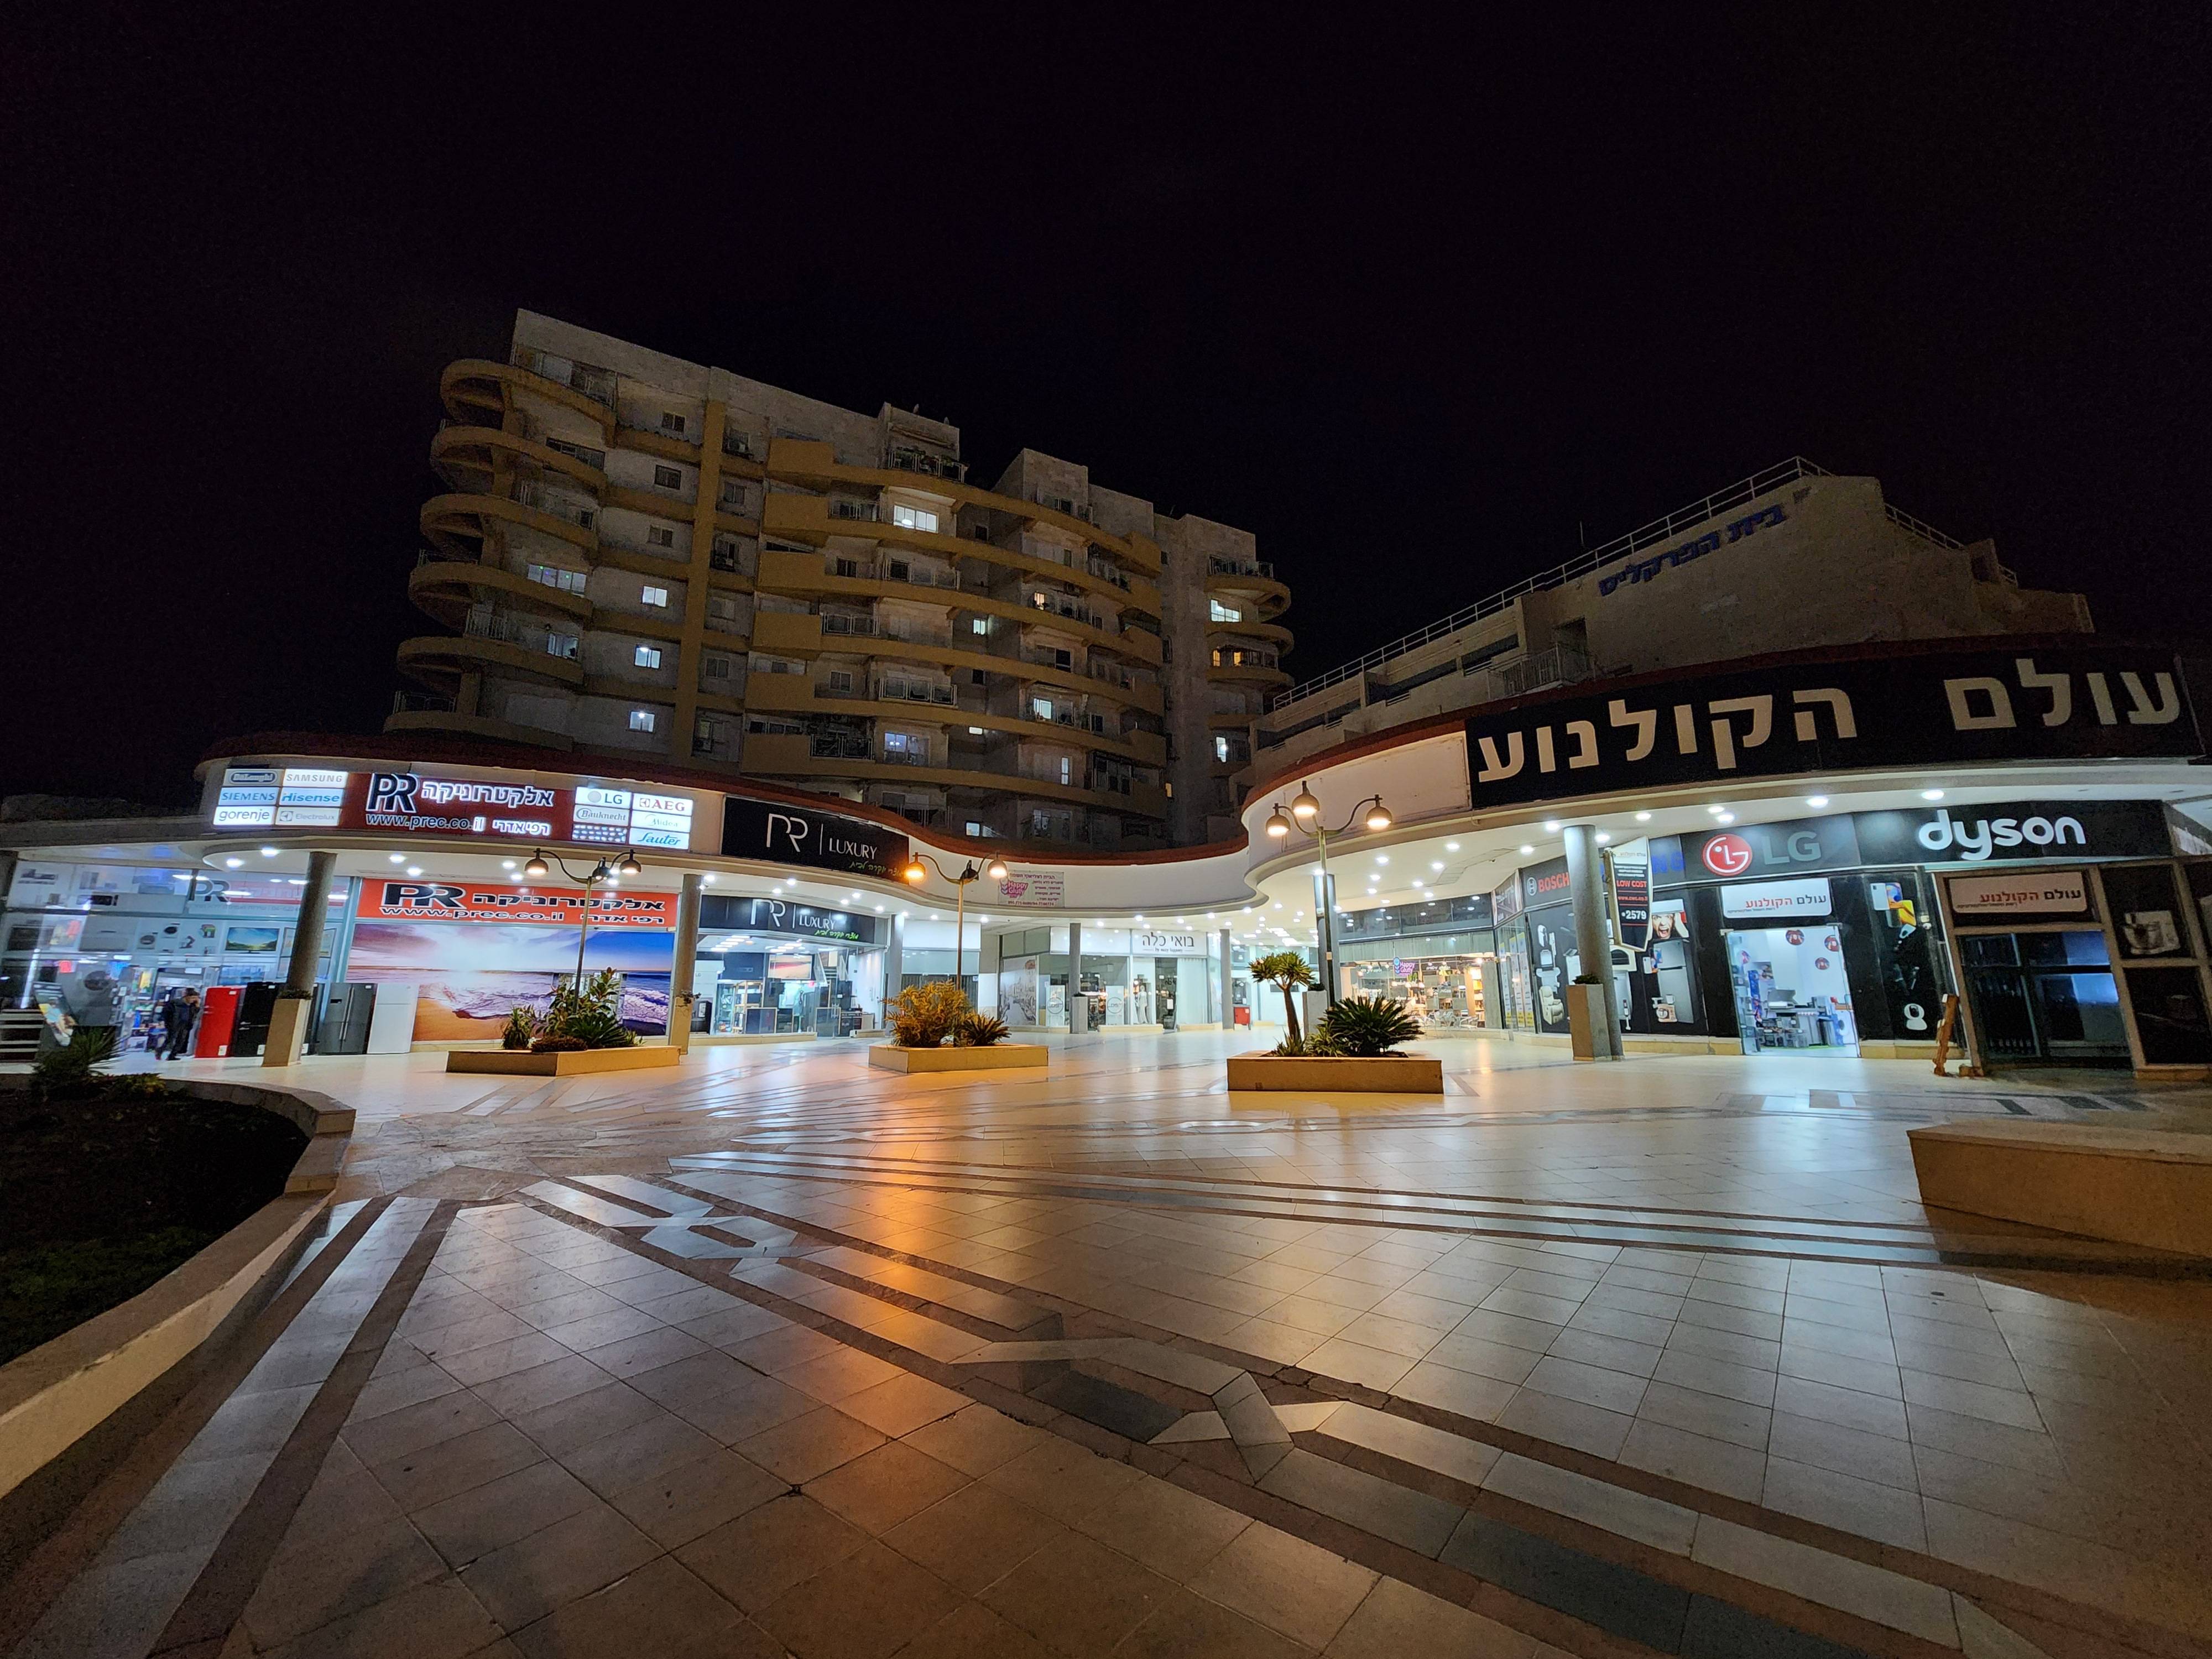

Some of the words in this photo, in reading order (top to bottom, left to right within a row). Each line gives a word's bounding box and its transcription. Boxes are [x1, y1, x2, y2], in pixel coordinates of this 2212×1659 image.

[1726, 504, 1787, 544] בית
[1943, 658, 2181, 731] עולם
[1478, 687, 1858, 783] הקולנוע
[286, 774, 342, 782] SAMSUNG
[222, 792, 275, 801] SIEMENS
[281, 792, 340, 802] Hisense
[366, 773, 418, 813] PR
[421, 781, 555, 808] אלקטרוניקה
[604, 793, 623, 805] LG
[651, 799, 686, 812] AEG
[219, 809, 270, 821] gorenje
[366, 813, 487, 831] www.prec.co.il
[581, 810, 627, 821] Bauknecht
[652, 817, 679, 827] Midea
[492, 819, 525, 833] אדרי
[526, 822, 551, 836] רפי
[766, 813, 808, 852] PR
[638, 832, 681, 846] Sauter
[1918, 809, 2086, 860] dyson
[830, 837, 878, 860] LUXURY
[1763, 831, 1822, 864] LG
[849, 860, 868, 870] לבית
[1009, 881, 1028, 890] Happy
[1538, 872, 1569, 893] BOSCH
[1631, 880, 1647, 888] COST
[383, 882, 466, 909] PR
[472, 892, 666, 911] אלקטרוניקה
[1796, 894, 1827, 905] עולם
[1979, 891, 2039, 904] הקולנוע
[2043, 889, 2081, 900] עולם
[1745, 897, 1793, 909] הקולנוע
[379, 906, 565, 921] www.prec.co.il
[631, 916, 664, 924] רפי
[750, 899, 786, 927] PR
[799, 912, 836, 930] LUXURY
[1142, 931, 1166, 946] כלה
[1171, 936, 1195, 947] בואי
[1400, 961, 1416, 969] Happy
